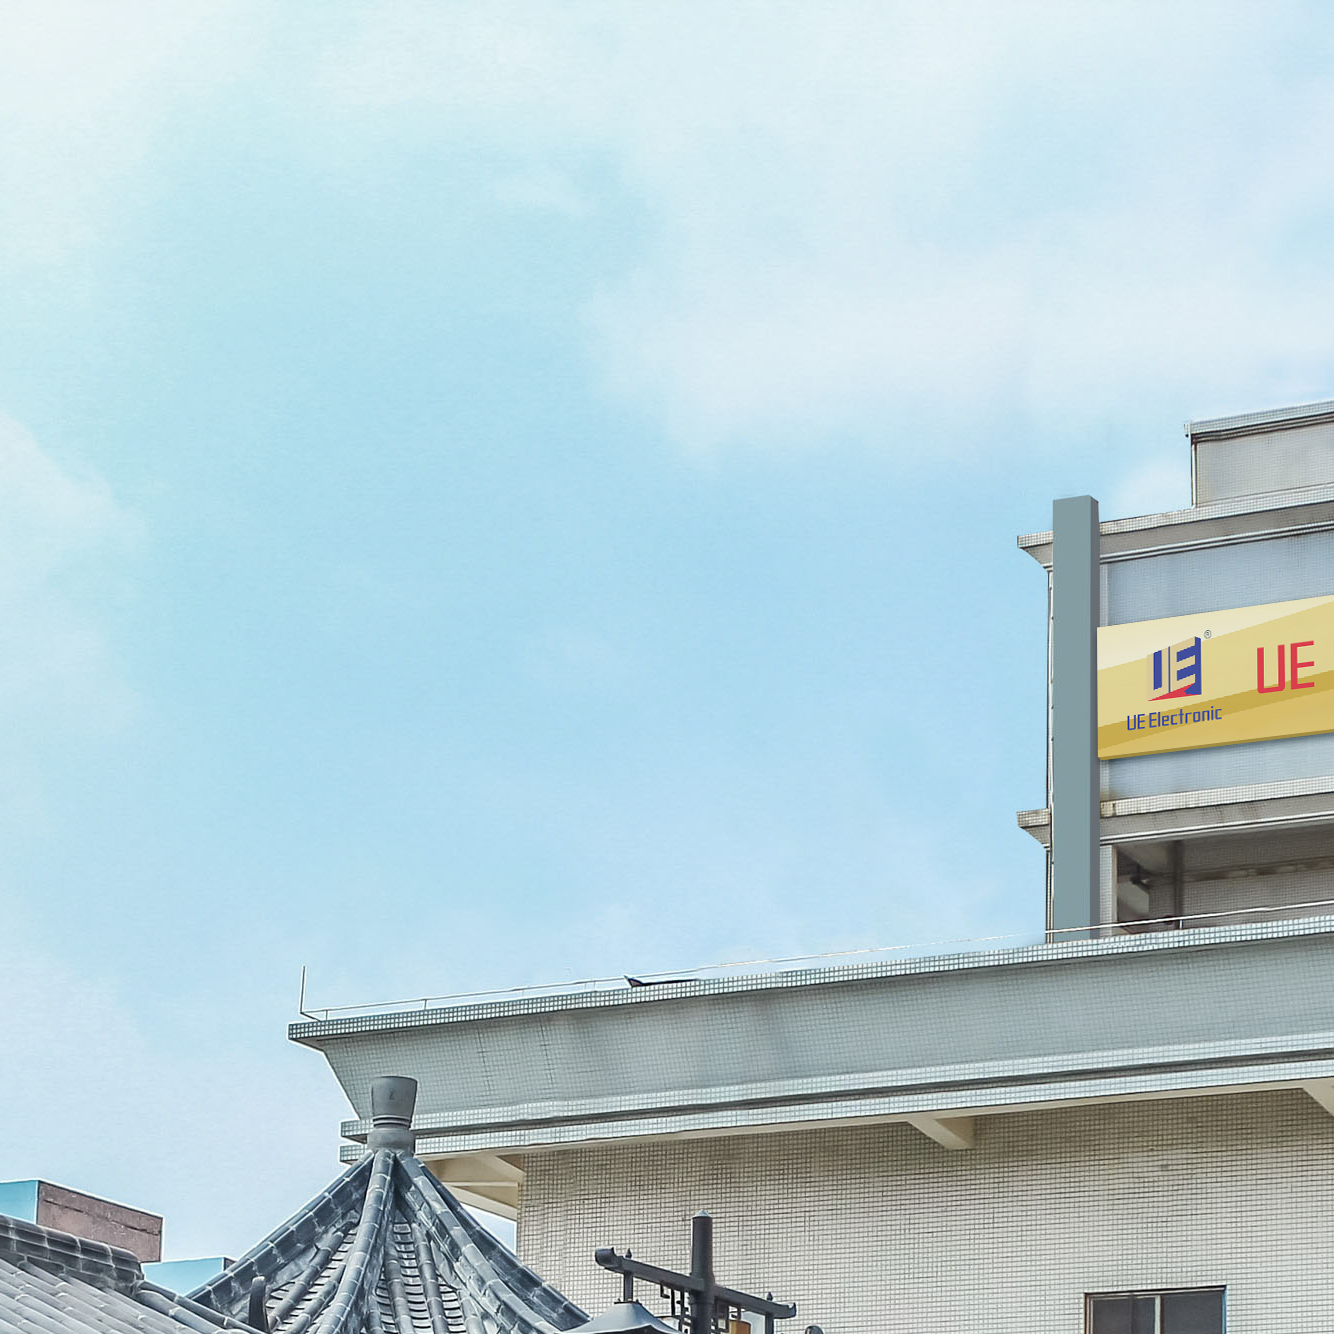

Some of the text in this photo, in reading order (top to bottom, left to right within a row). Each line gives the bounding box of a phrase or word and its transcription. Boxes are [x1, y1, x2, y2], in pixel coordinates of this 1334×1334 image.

[1256, 640, 1315, 694] UE
[1127, 705, 1223, 731] UE Electronic
